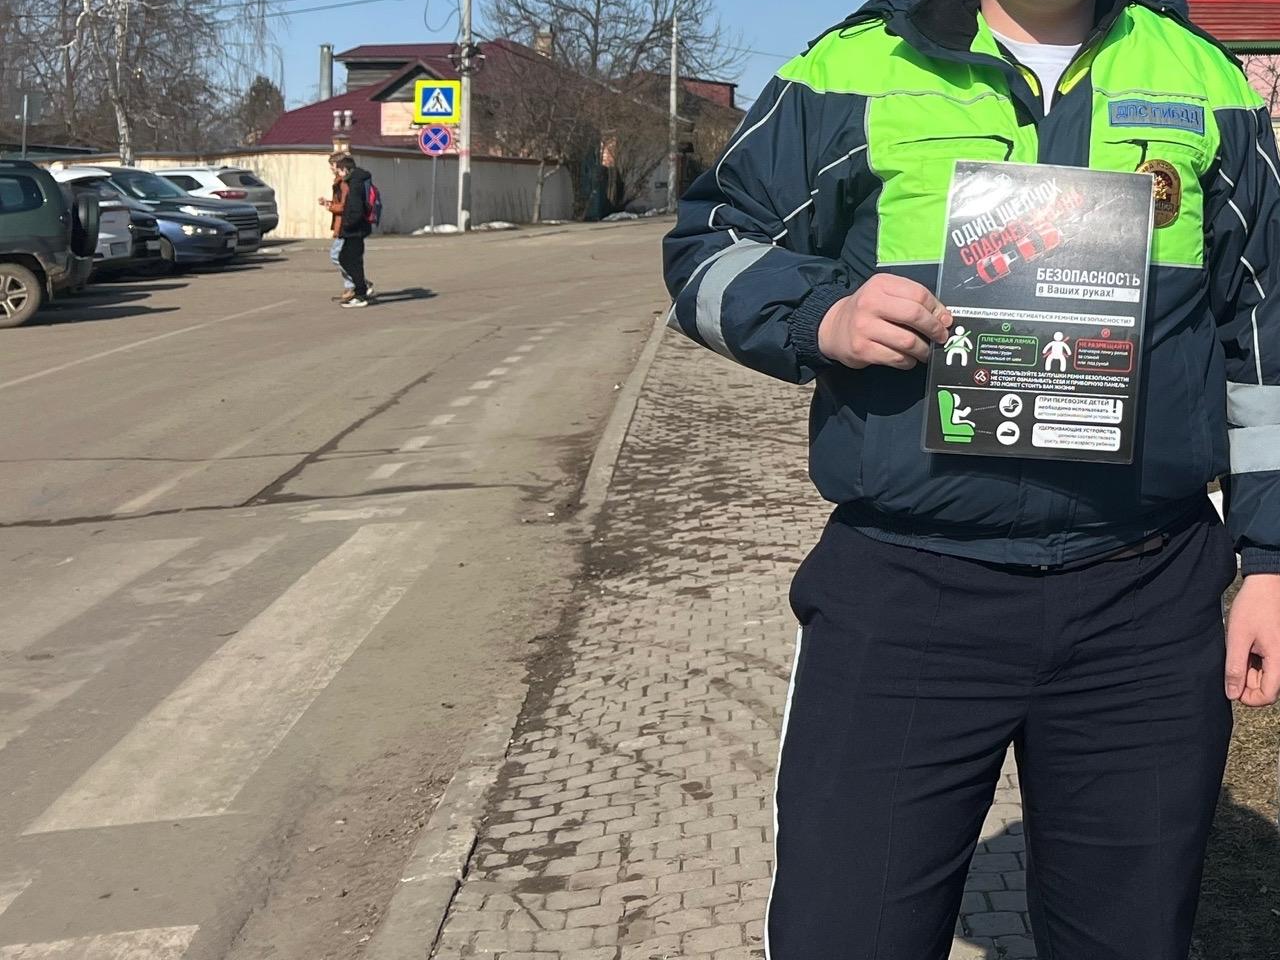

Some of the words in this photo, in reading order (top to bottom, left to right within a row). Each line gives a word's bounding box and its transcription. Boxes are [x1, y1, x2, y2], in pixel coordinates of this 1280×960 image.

[1117, 104, 1148, 118] ДПС
[1151, 106, 1199, 125] ГИБДД
[952, 211, 998, 248] ОДИН
[996, 177, 1063, 220] ЩЕЛЧОК
[1036, 268, 1140, 286] БЕЗОПАСНОСТЬ
[1047, 285, 1079, 295] Ваших
[1083, 288, 1114, 298] руках!
